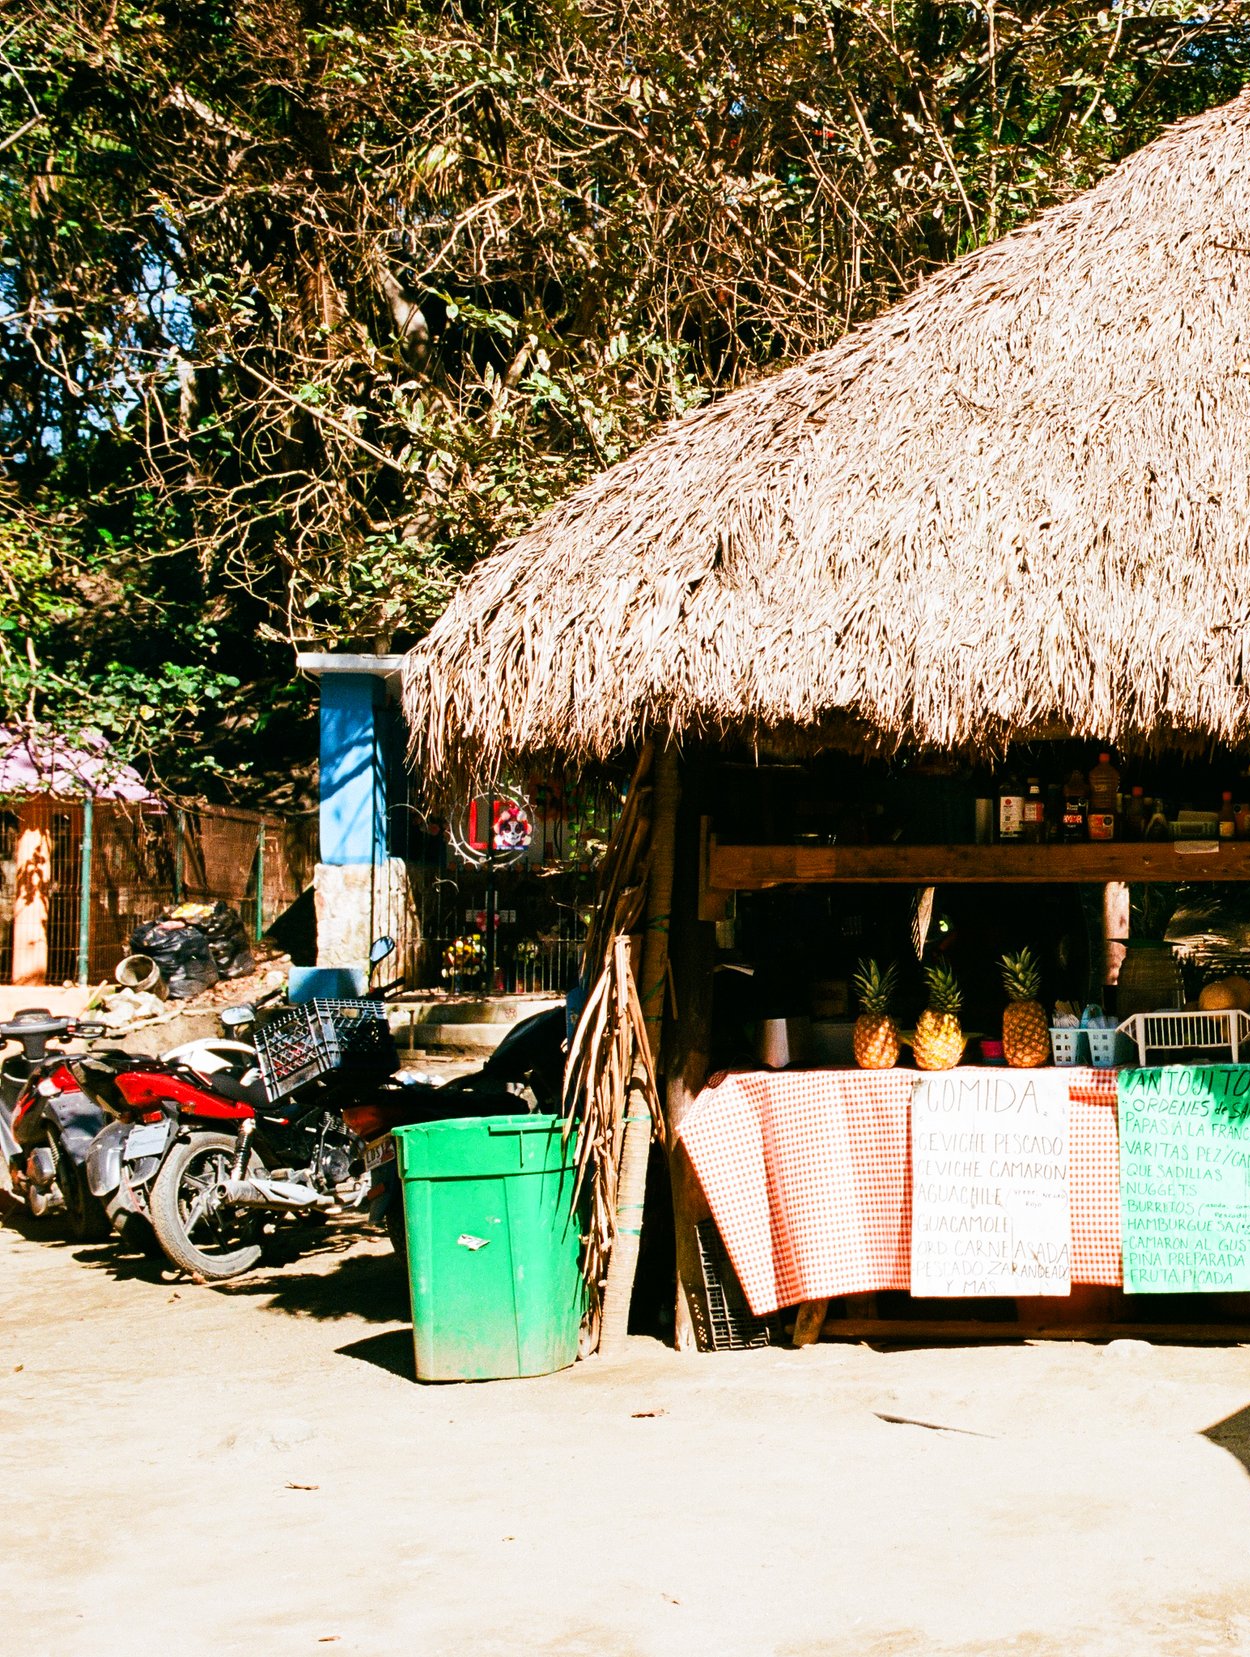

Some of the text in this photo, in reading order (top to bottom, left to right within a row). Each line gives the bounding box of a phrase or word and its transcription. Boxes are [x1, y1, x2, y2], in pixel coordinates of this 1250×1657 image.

[1132, 1098, 1210, 1117] ORDENES
[1214, 1101, 1228, 1114] de
[1172, 1120, 1183, 1136] A
[1187, 1121, 1206, 1137] LA
[918, 1132, 1063, 1156] CEVICHE PESCADO
[916, 1158, 982, 1179] CEVICHE
[917, 1183, 1003, 1207] AGUACHILE
[917, 1215, 1008, 1234] GUACAMOLE
[917, 1239, 1070, 1264] ORD CARNE ASADA
[1195, 1237, 1212, 1251] AL
[1168, 1250, 1245, 1267] PREPARADA
[916, 1260, 984, 1278] PESCADO
[1183, 1269, 1234, 1286] PICADA
[946, 1280, 954, 1293] Y
